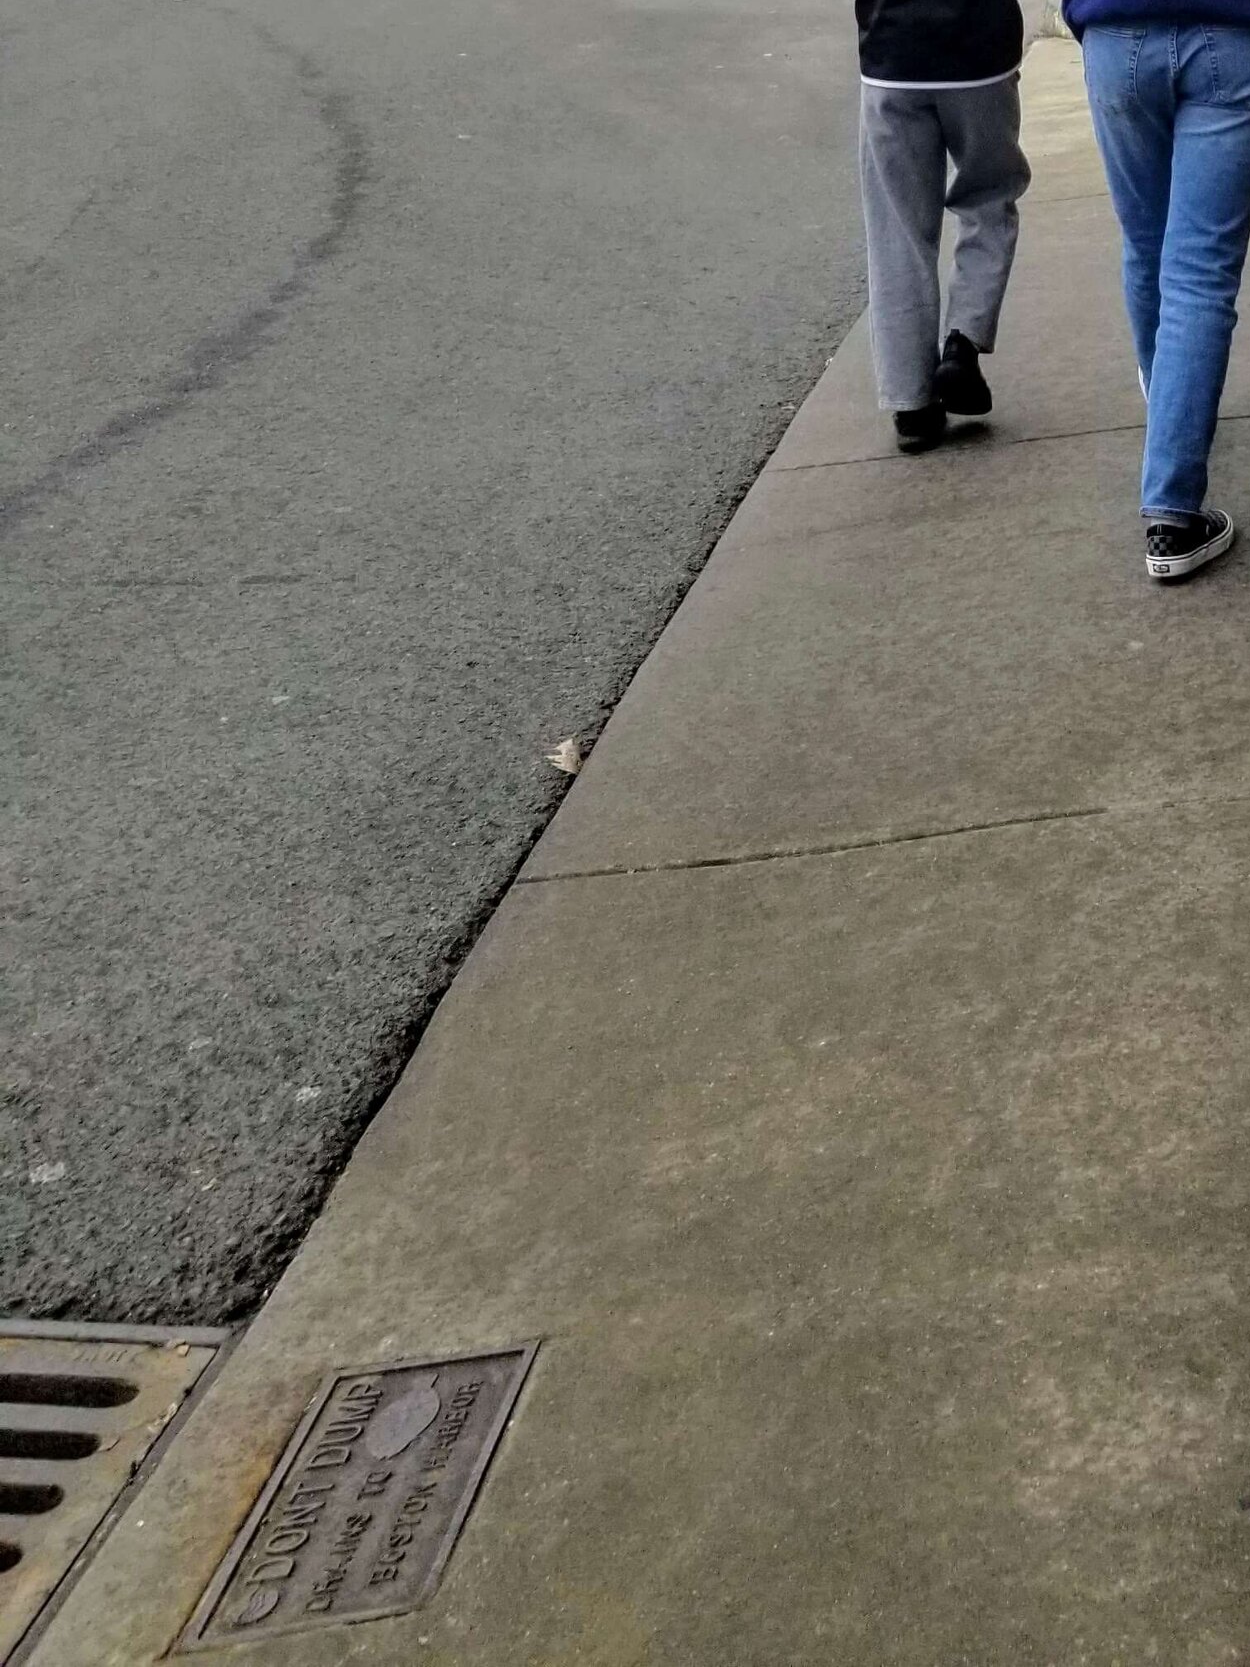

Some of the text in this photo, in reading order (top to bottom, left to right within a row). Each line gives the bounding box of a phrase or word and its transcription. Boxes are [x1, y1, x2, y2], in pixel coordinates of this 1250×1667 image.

[305, 1382, 384, 1470] DUMP
[357, 1468, 393, 1500] TO
[368, 1482, 437, 1585] BOSTON
